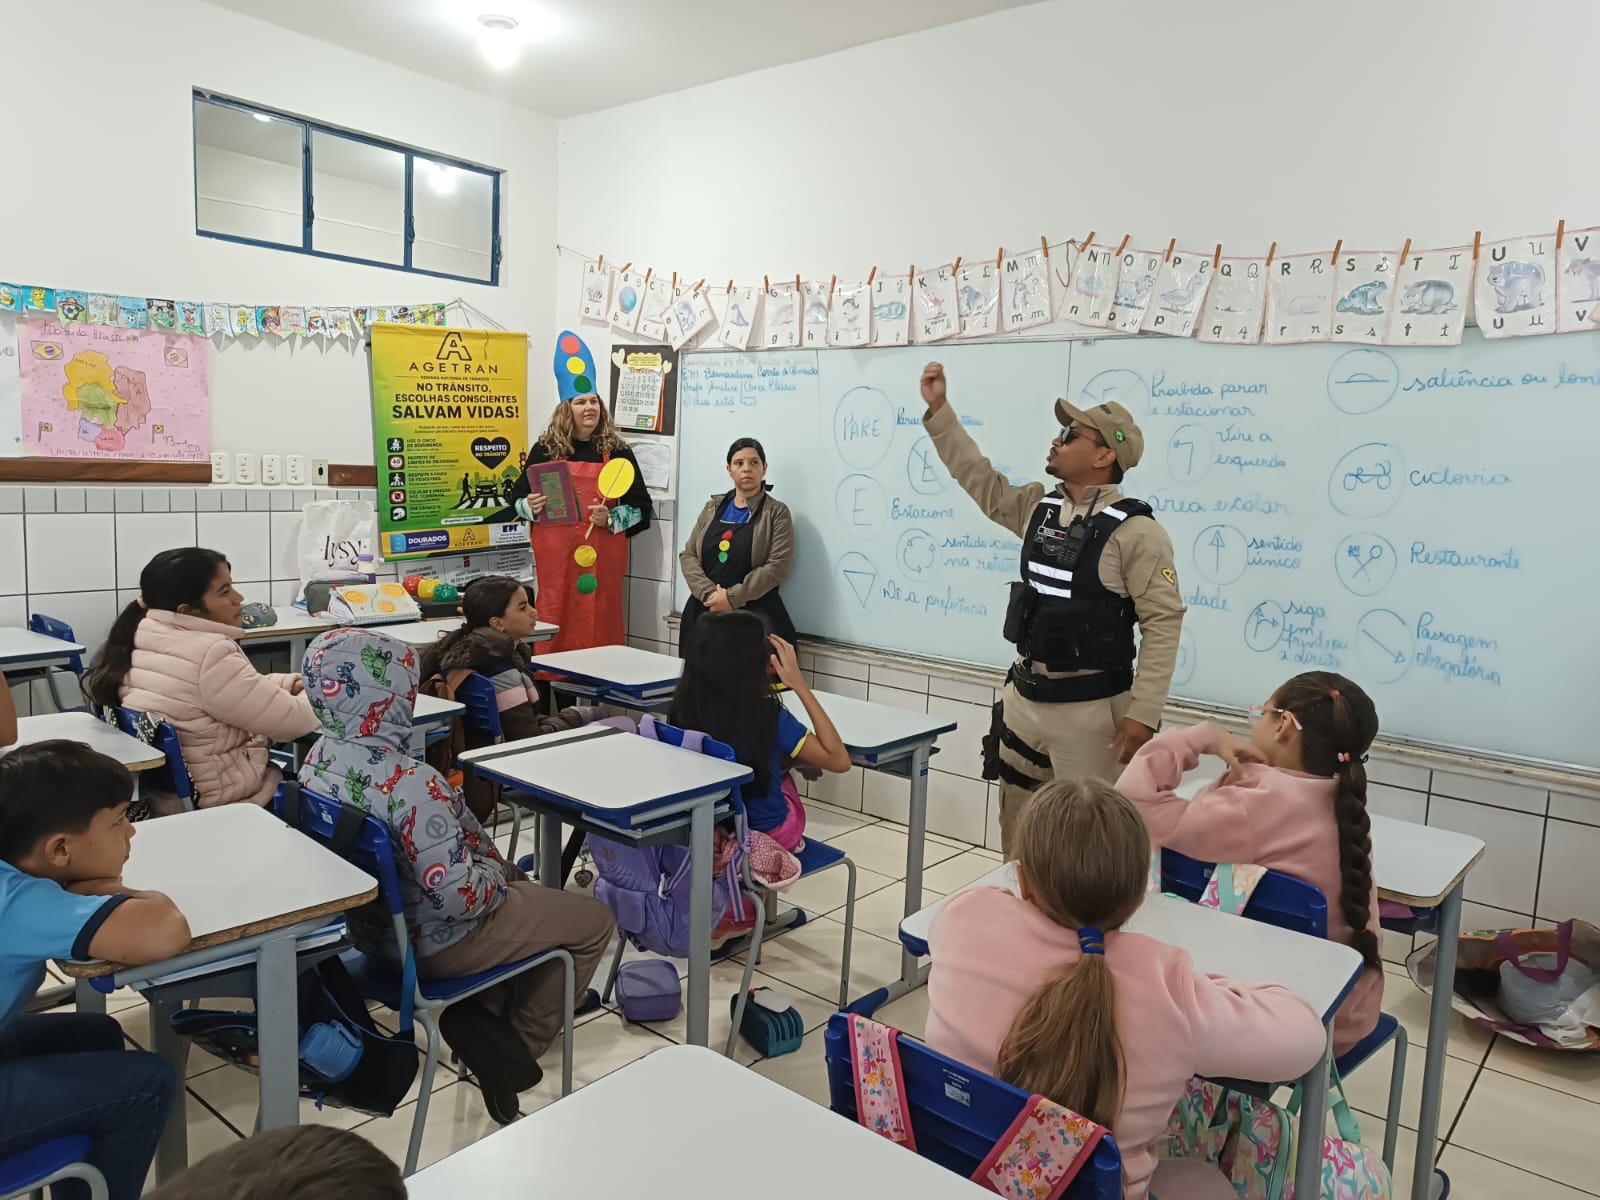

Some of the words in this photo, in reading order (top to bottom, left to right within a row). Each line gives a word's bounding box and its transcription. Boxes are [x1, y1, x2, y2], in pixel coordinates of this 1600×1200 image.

[1574, 236, 1589, 252] V
[1088, 250, 1098, 262] N
[1492, 246, 1506, 261] U
[1006, 260, 1018, 273] M
[1124, 254, 1134, 267] O
[1172, 256, 1182, 268] P
[1346, 258, 1356, 272] S
[1413, 257, 1423, 271] T
[588, 264, 595, 274] A
[1220, 263, 1232, 277] Q
[1281, 262, 1291, 276] R
[1309, 258, 1323, 275] R
[623, 273, 629, 282] B
[918, 277, 927, 288] K
[649, 280, 655, 290] C
[876, 281, 882, 293] J
[675, 287, 681, 297] D
[770, 287, 778, 298] G
[584, 306, 590, 314] a
[1070, 305, 1078, 314] n
[1575, 309, 1587, 322] v
[613, 311, 619, 321] b
[1011, 313, 1023, 323] m
[1108, 311, 1116, 321] o
[1154, 315, 1165, 327] p
[642, 324, 648, 332] c
[924, 325, 932, 335] k
[1212, 325, 1222, 339] q
[1280, 325, 1287, 336] r
[1335, 324, 1344, 335] s
[1404, 323, 1412, 336] t
[771, 333, 778, 345] g
[807, 331, 814, 341] h
[873, 331, 879, 343] j
[409, 361, 498, 374] AGETRAN
[1403, 367, 1514, 391] saliência
[1521, 372, 1549, 385] ou
[416, 382, 433, 392] NO
[436, 382, 492, 393] TRÂNSITO,
[1220, 382, 1268, 400] parar
[395, 393, 450, 403] ESCOLHAS
[452, 394, 517, 403] CONSCIENTES
[392, 405, 461, 419] SALVAM
[467, 405, 519, 419] VIDAS!
[1165, 401, 1256, 417] estacionar
[843, 412, 881, 441] PARE
[474, 444, 508, 452] RESPEITO
[852, 487, 873, 526] E
[408, 535, 447, 545] DOURADOS
[1248, 535, 1303, 551] sentido
[1410, 541, 1522, 570] Restaurante
[1416, 611, 1498, 657] Passagem
